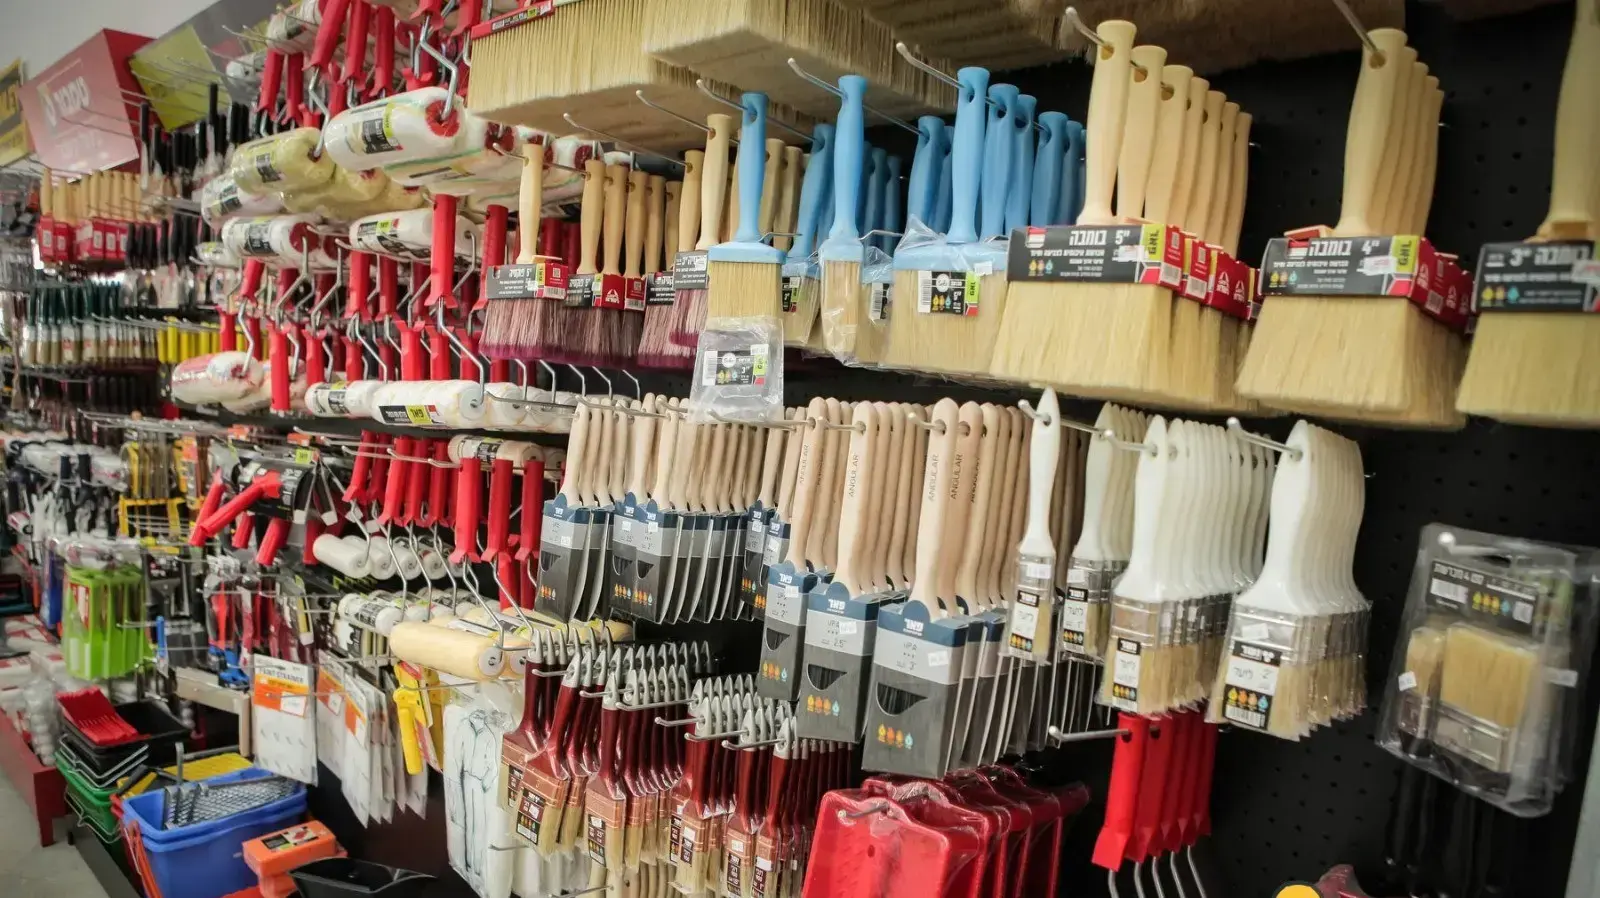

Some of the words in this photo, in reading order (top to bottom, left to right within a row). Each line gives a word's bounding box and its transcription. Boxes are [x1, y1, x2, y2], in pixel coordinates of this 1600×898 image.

[1068, 229, 1107, 246] בומבה
[1308, 239, 1353, 257] בומבה
[848, 454, 859, 498] ANGULAR
[950, 453, 963, 500] ANGULAR
